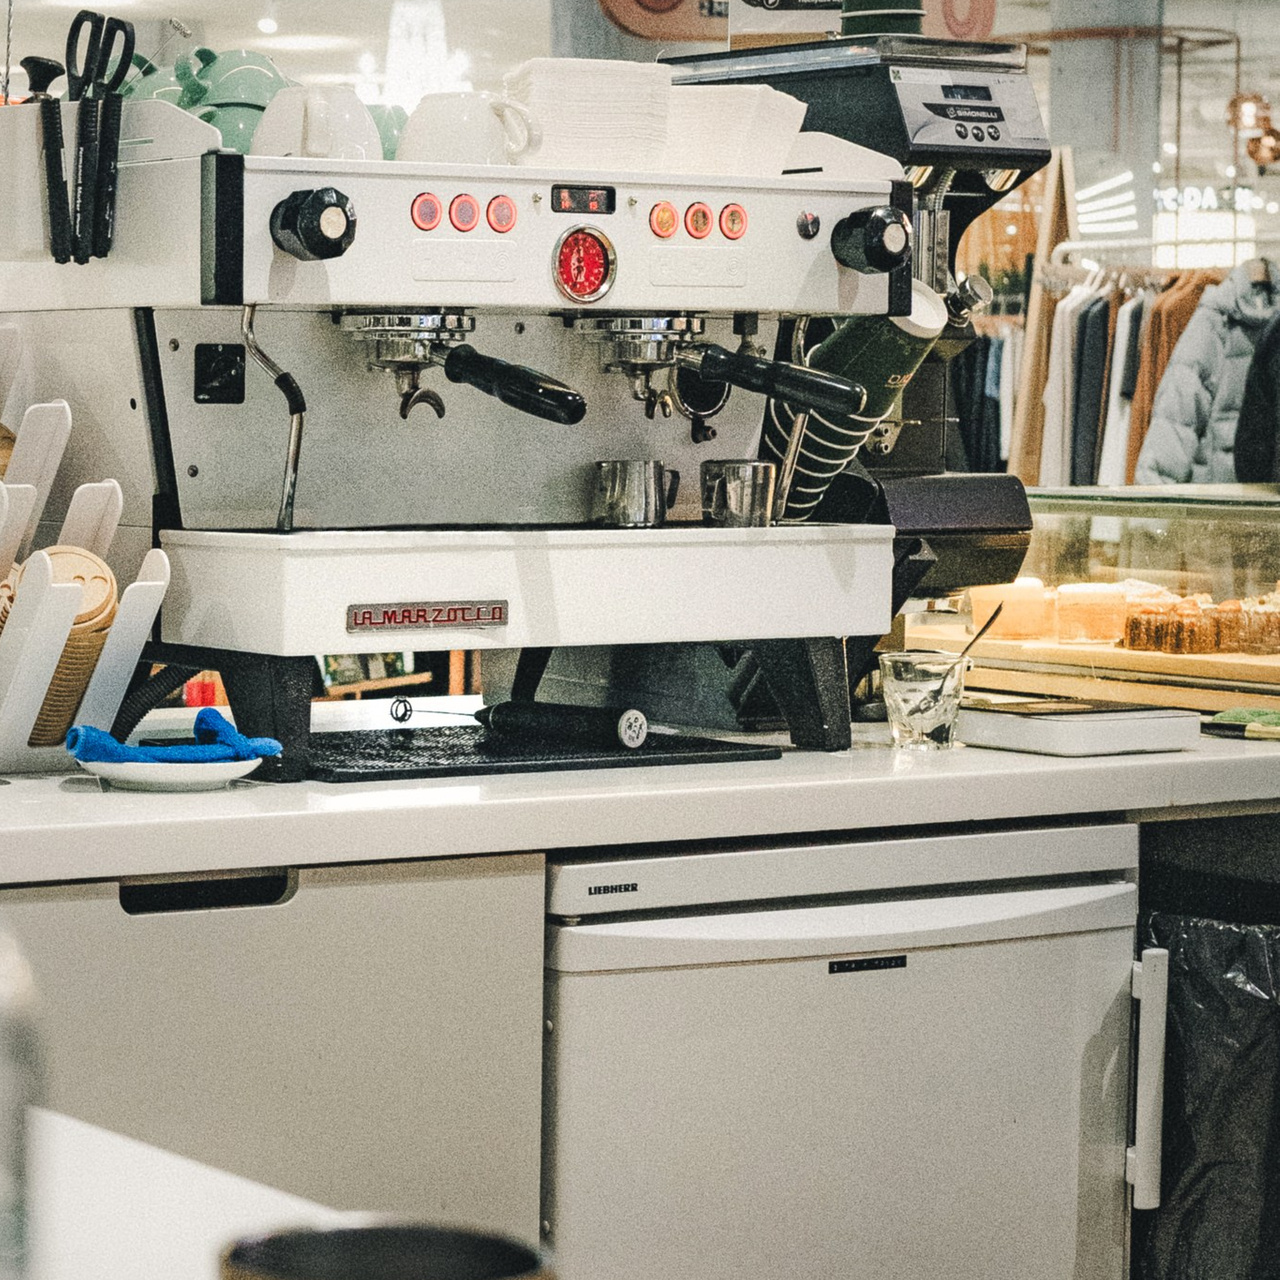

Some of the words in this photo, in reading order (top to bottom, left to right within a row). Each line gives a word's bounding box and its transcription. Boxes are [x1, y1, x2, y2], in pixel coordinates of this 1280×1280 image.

[956, 110, 998, 119] SIMONELLI
[353, 610, 371, 626] LA
[382, 605, 503, 625] MARZOCCO
[588, 882, 638, 896] LIEBHERR
